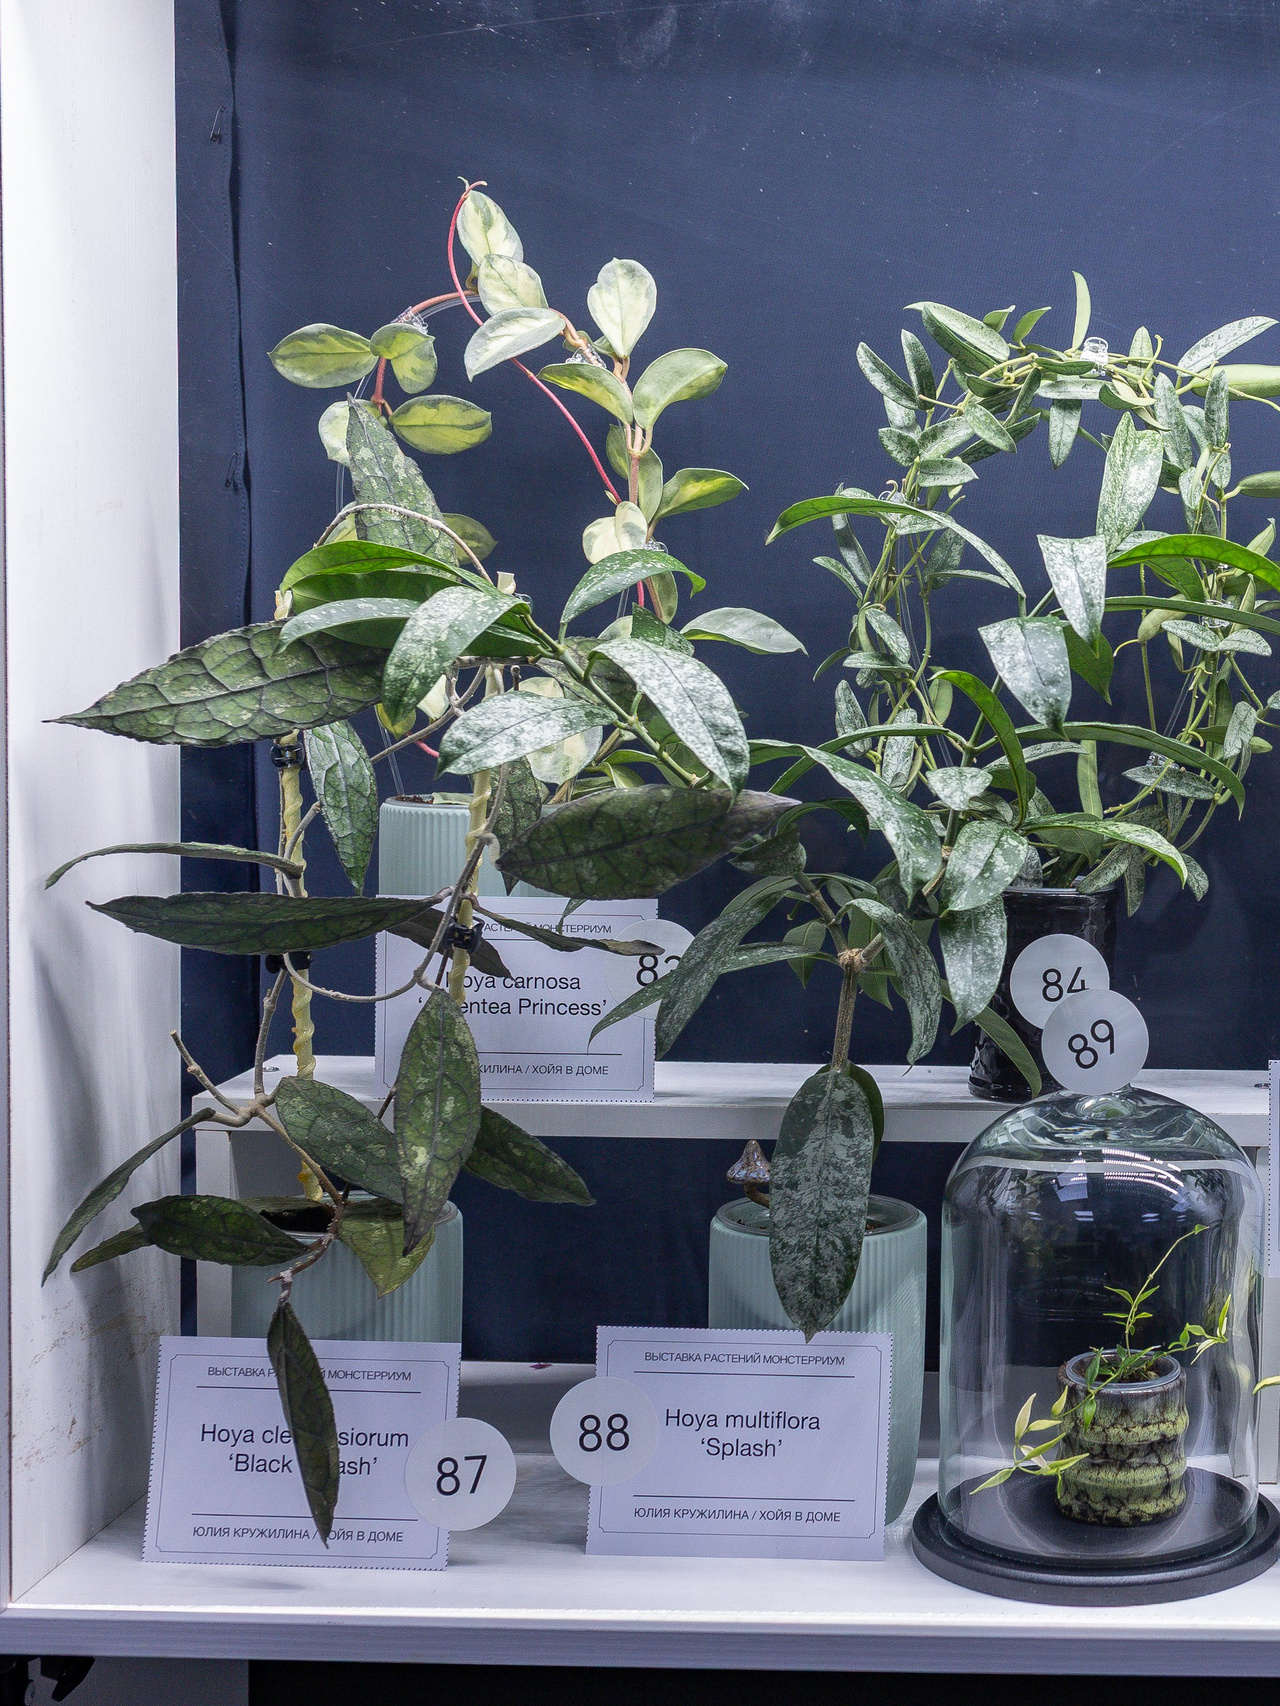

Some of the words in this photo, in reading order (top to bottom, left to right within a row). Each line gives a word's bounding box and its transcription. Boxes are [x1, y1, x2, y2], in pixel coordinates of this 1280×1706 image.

[502, 975, 581, 990] carnosa
[1042, 966, 1091, 1002] 84
[518, 998, 608, 1017] Princess’
[1067, 1019, 1115, 1070] 89
[531, 1063, 563, 1075] ХОЙЯ
[565, 1065, 574, 1075] В
[575, 1065, 609, 1077] ДОМЕ
[644, 1351, 702, 1363] ВЫСТАВКА
[703, 1352, 761, 1365] РАСТЕНИЙ
[763, 1354, 846, 1367] МОНСТЕРРИУМ
[207, 1366, 266, 1378] ВЫСТАВКА
[328, 1369, 412, 1382] МОНСТЕРРИУМ
[665, 1408, 719, 1431] Hoya
[725, 1410, 821, 1430] multiflora
[201, 1423, 255, 1447] Hoya
[261, 1424, 409, 1448] clesiorum
[578, 1412, 631, 1453] 88
[700, 1437, 783, 1461] ‘Splash’
[228, 1453, 293, 1474] ‘Black
[435, 1454, 489, 1497] 87
[633, 1507, 671, 1519] ЮЛИЯ
[673, 1508, 750, 1521] КРУЖИЛИНА
[758, 1508, 792, 1522] ХОЙЯ
[795, 1511, 804, 1522] В
[805, 1511, 841, 1525] ДОМЕ
[192, 1525, 231, 1538] ЮЛИЯ
[233, 1527, 310, 1540] КРУЖИЛИНА
[356, 1530, 365, 1541] В
[366, 1531, 404, 1544] ДОМЕ
